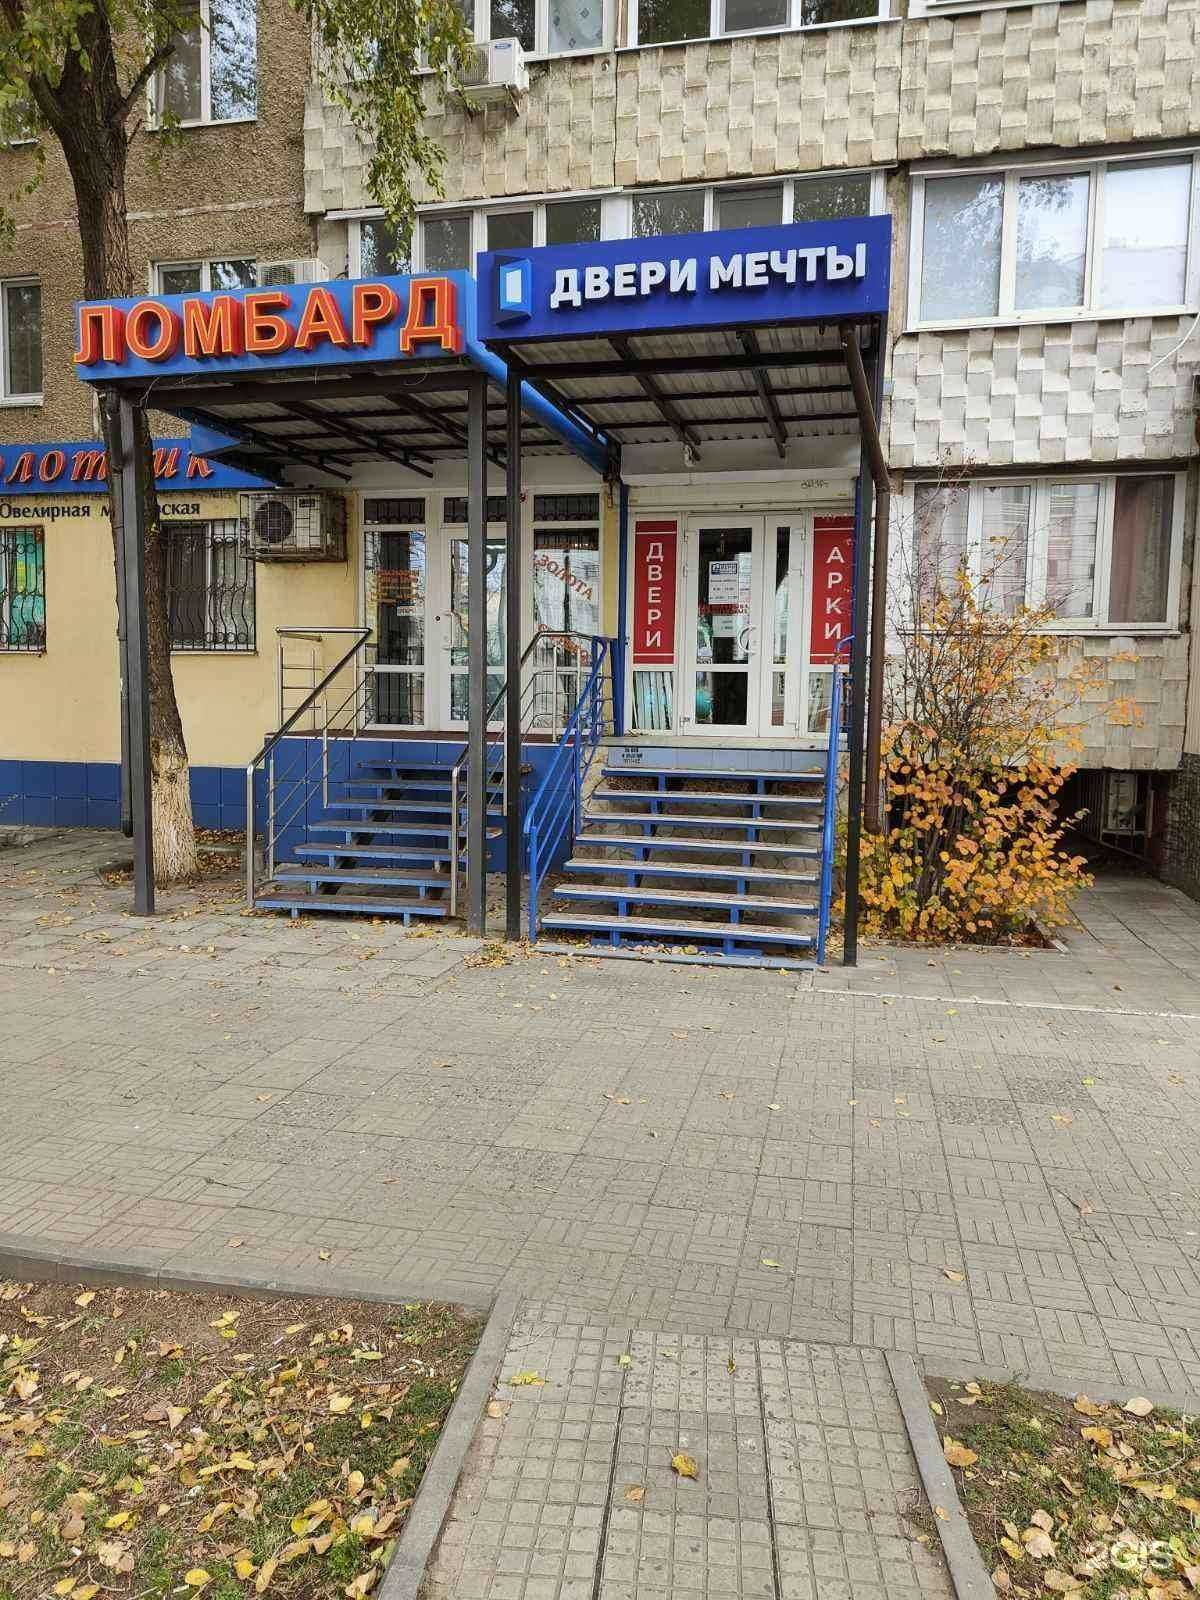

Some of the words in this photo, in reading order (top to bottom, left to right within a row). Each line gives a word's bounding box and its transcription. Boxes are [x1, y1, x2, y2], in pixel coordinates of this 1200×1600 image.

[73, 276, 462, 366] ЛОМБАРД
[550, 258, 697, 309] ДВЕРИ
[709, 243, 867, 290] МЕЧТЫ
[646, 542, 664, 648] ДВЕРИ
[824, 546, 844, 640] АРКИ
